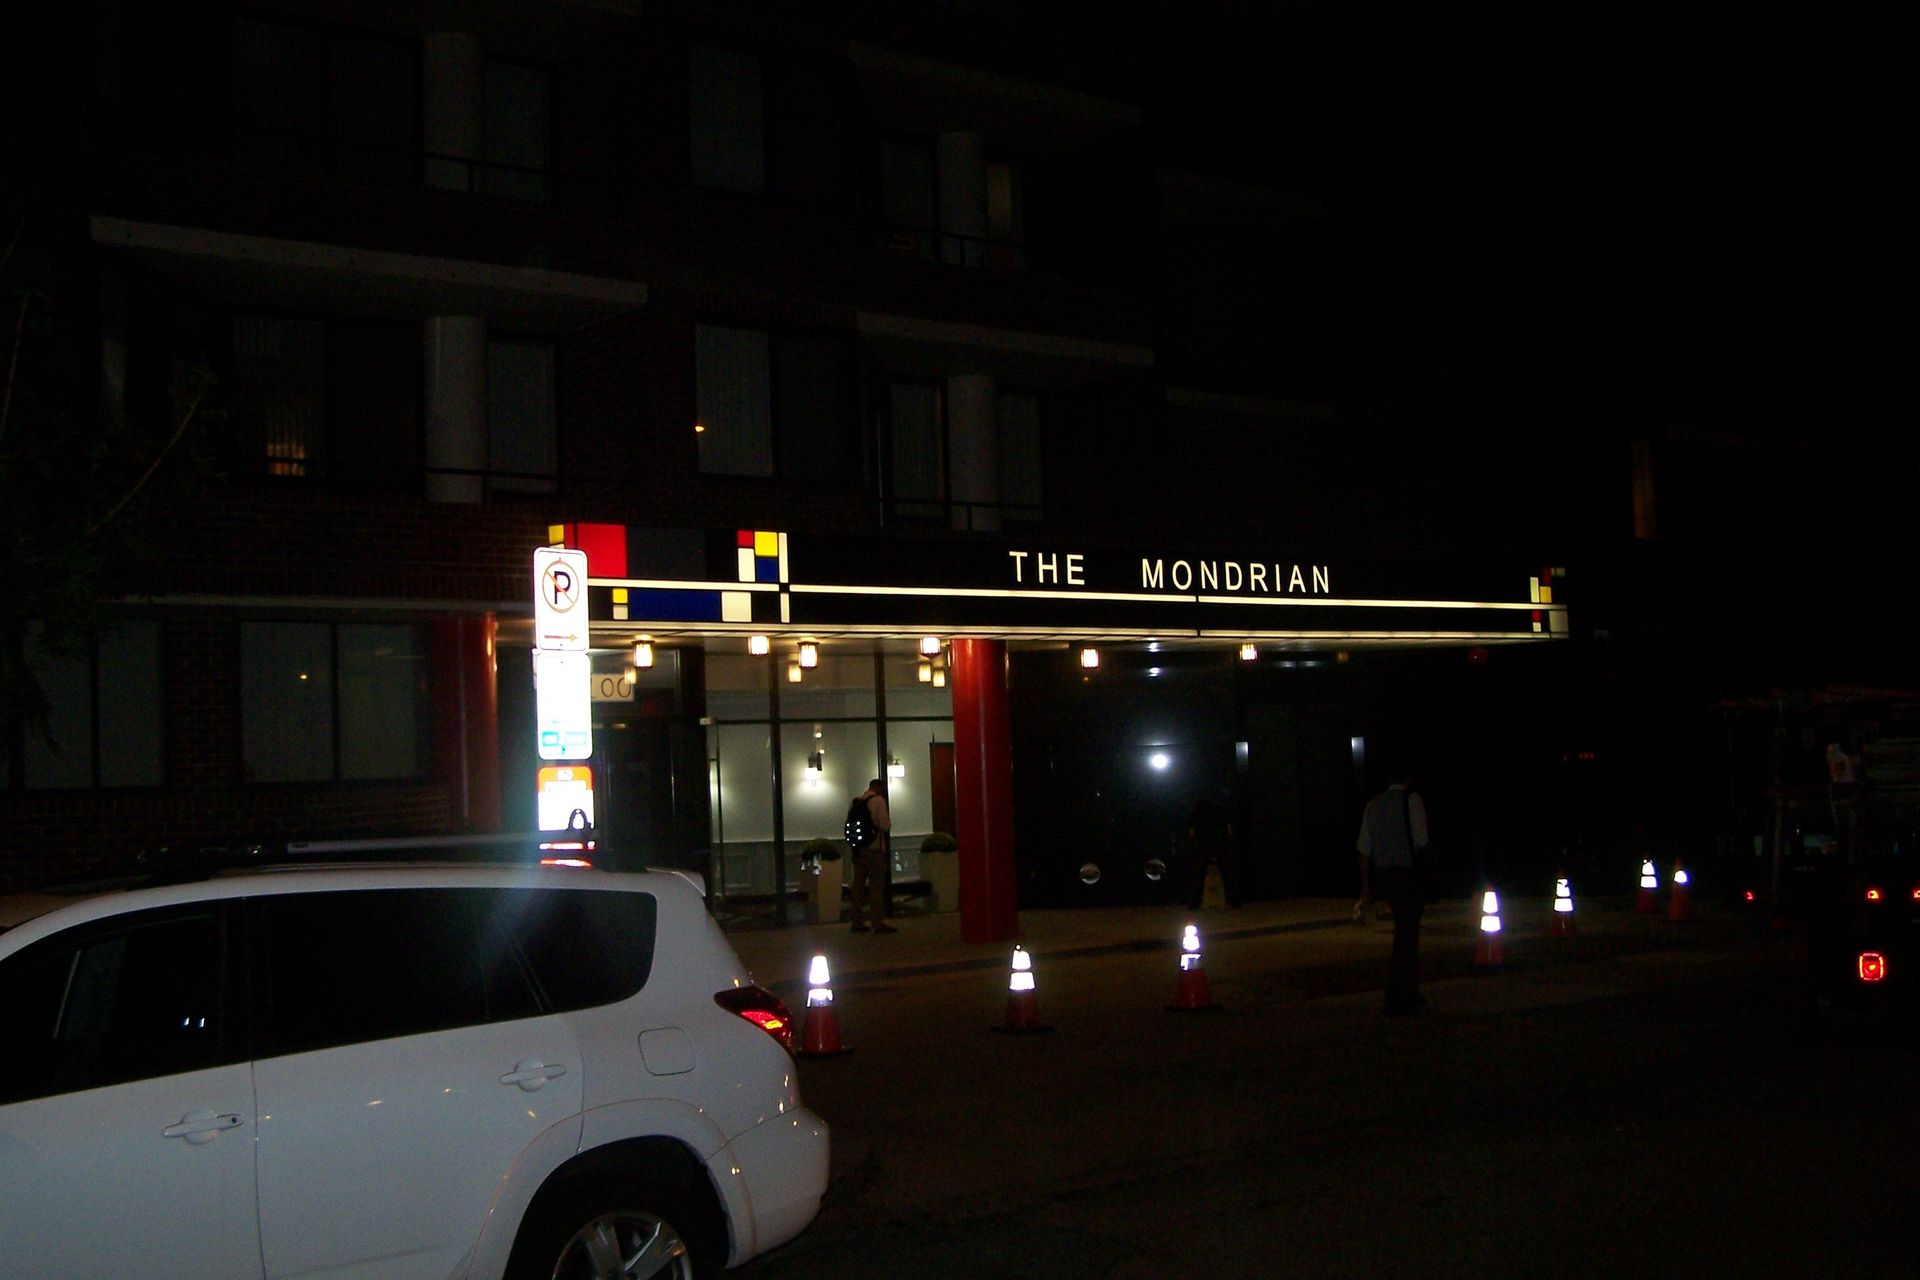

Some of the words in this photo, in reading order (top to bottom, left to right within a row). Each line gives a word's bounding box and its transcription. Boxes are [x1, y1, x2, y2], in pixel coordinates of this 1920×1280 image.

[1008, 551, 1085, 586] THE
[1141, 558, 1330, 594] MONDRIAN
[592, 677, 632, 698] 00
